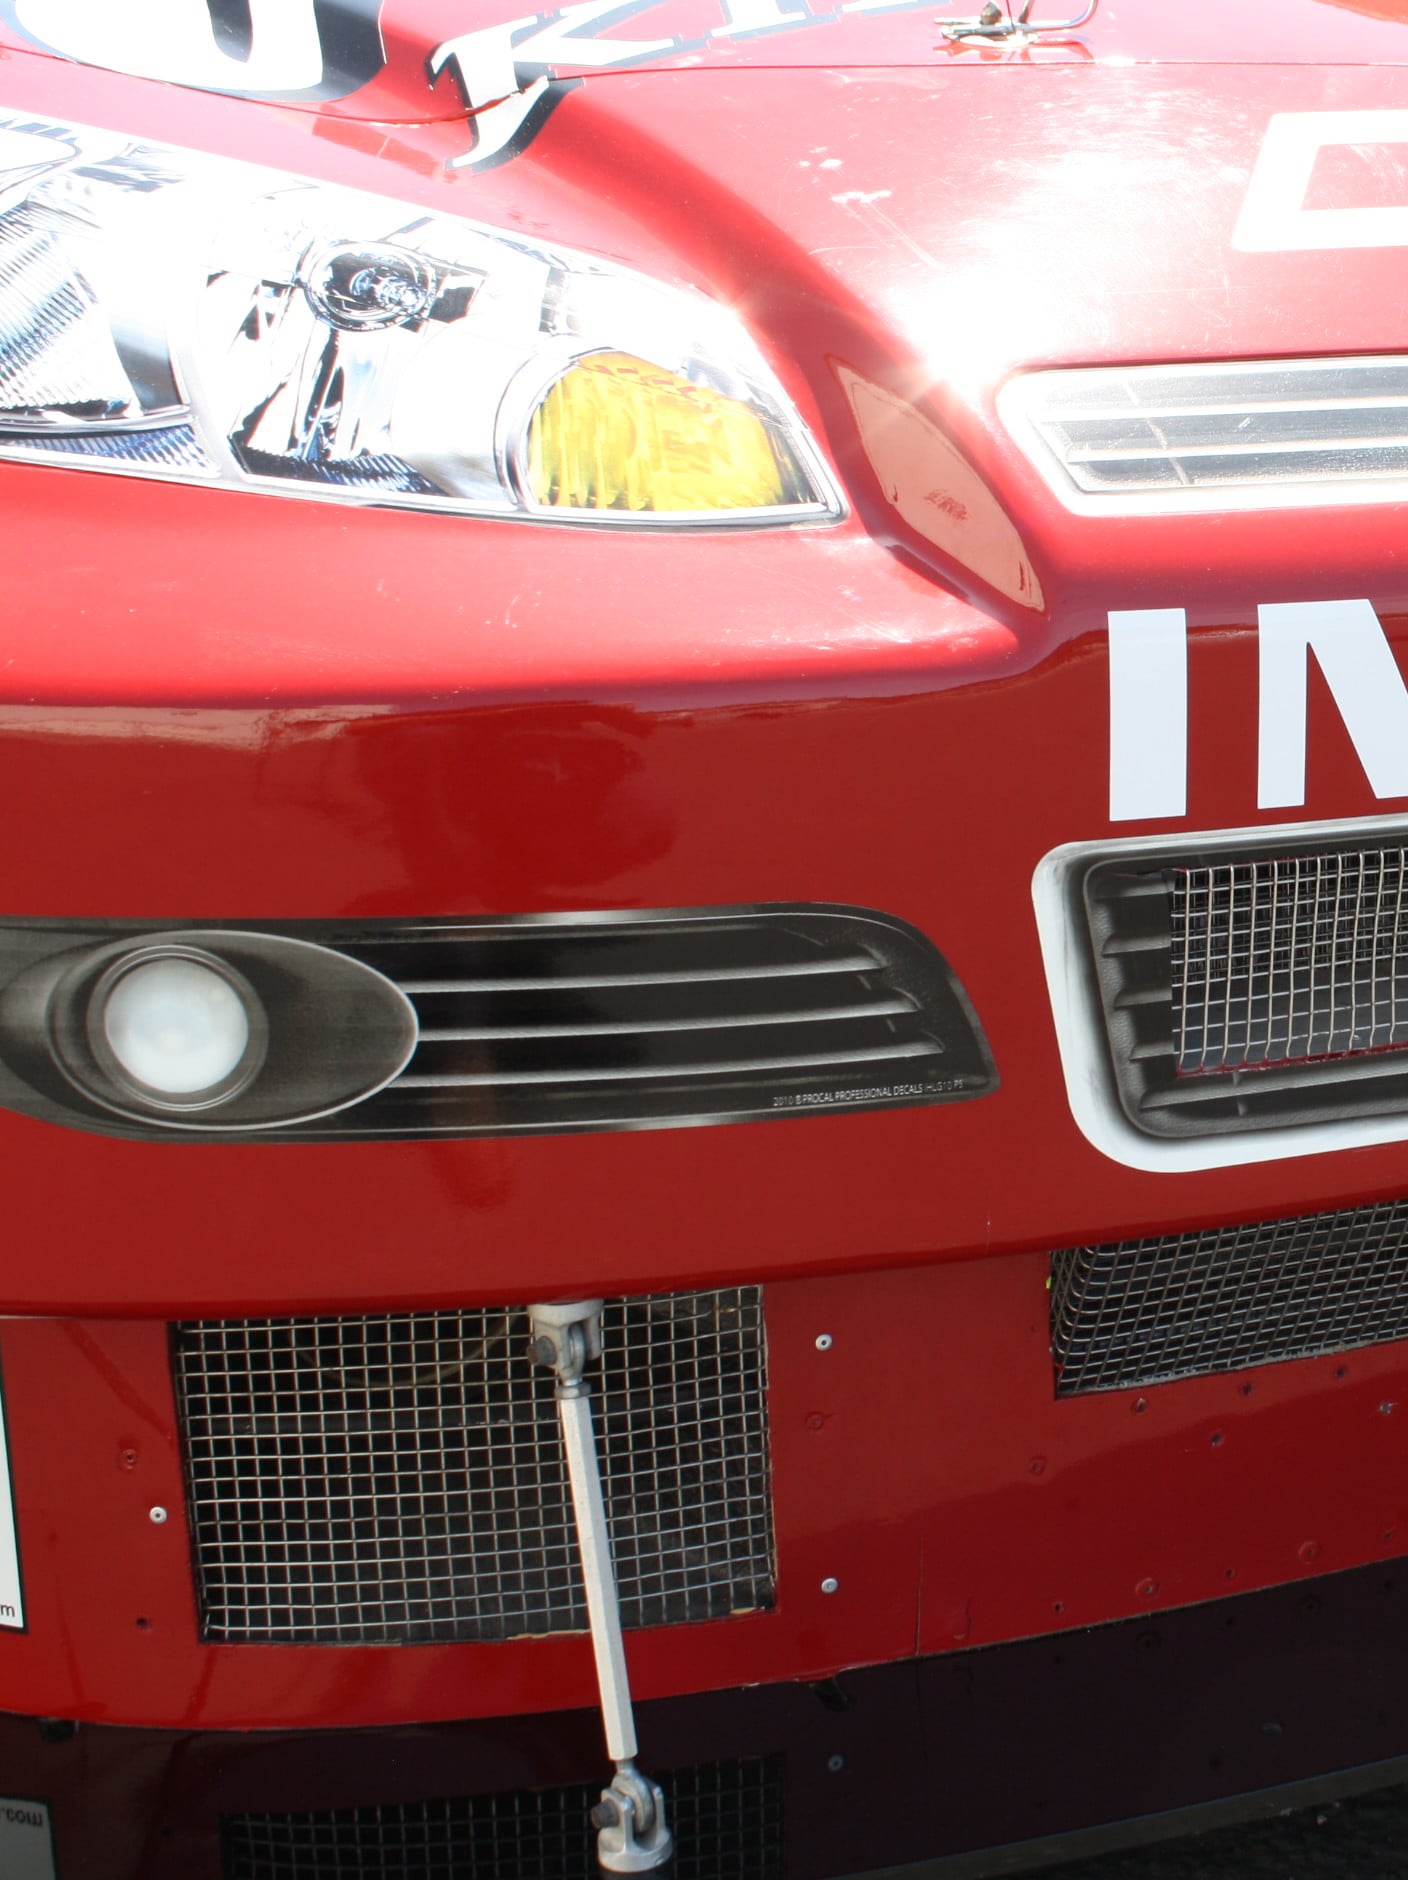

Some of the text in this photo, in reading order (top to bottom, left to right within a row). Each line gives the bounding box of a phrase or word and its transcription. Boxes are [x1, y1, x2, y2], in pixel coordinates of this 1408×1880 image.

[803, 1092, 834, 1104] PROCAL
[835, 1087, 892, 1101] PROFESSIONAL
[893, 1083, 923, 1096] DECALS
